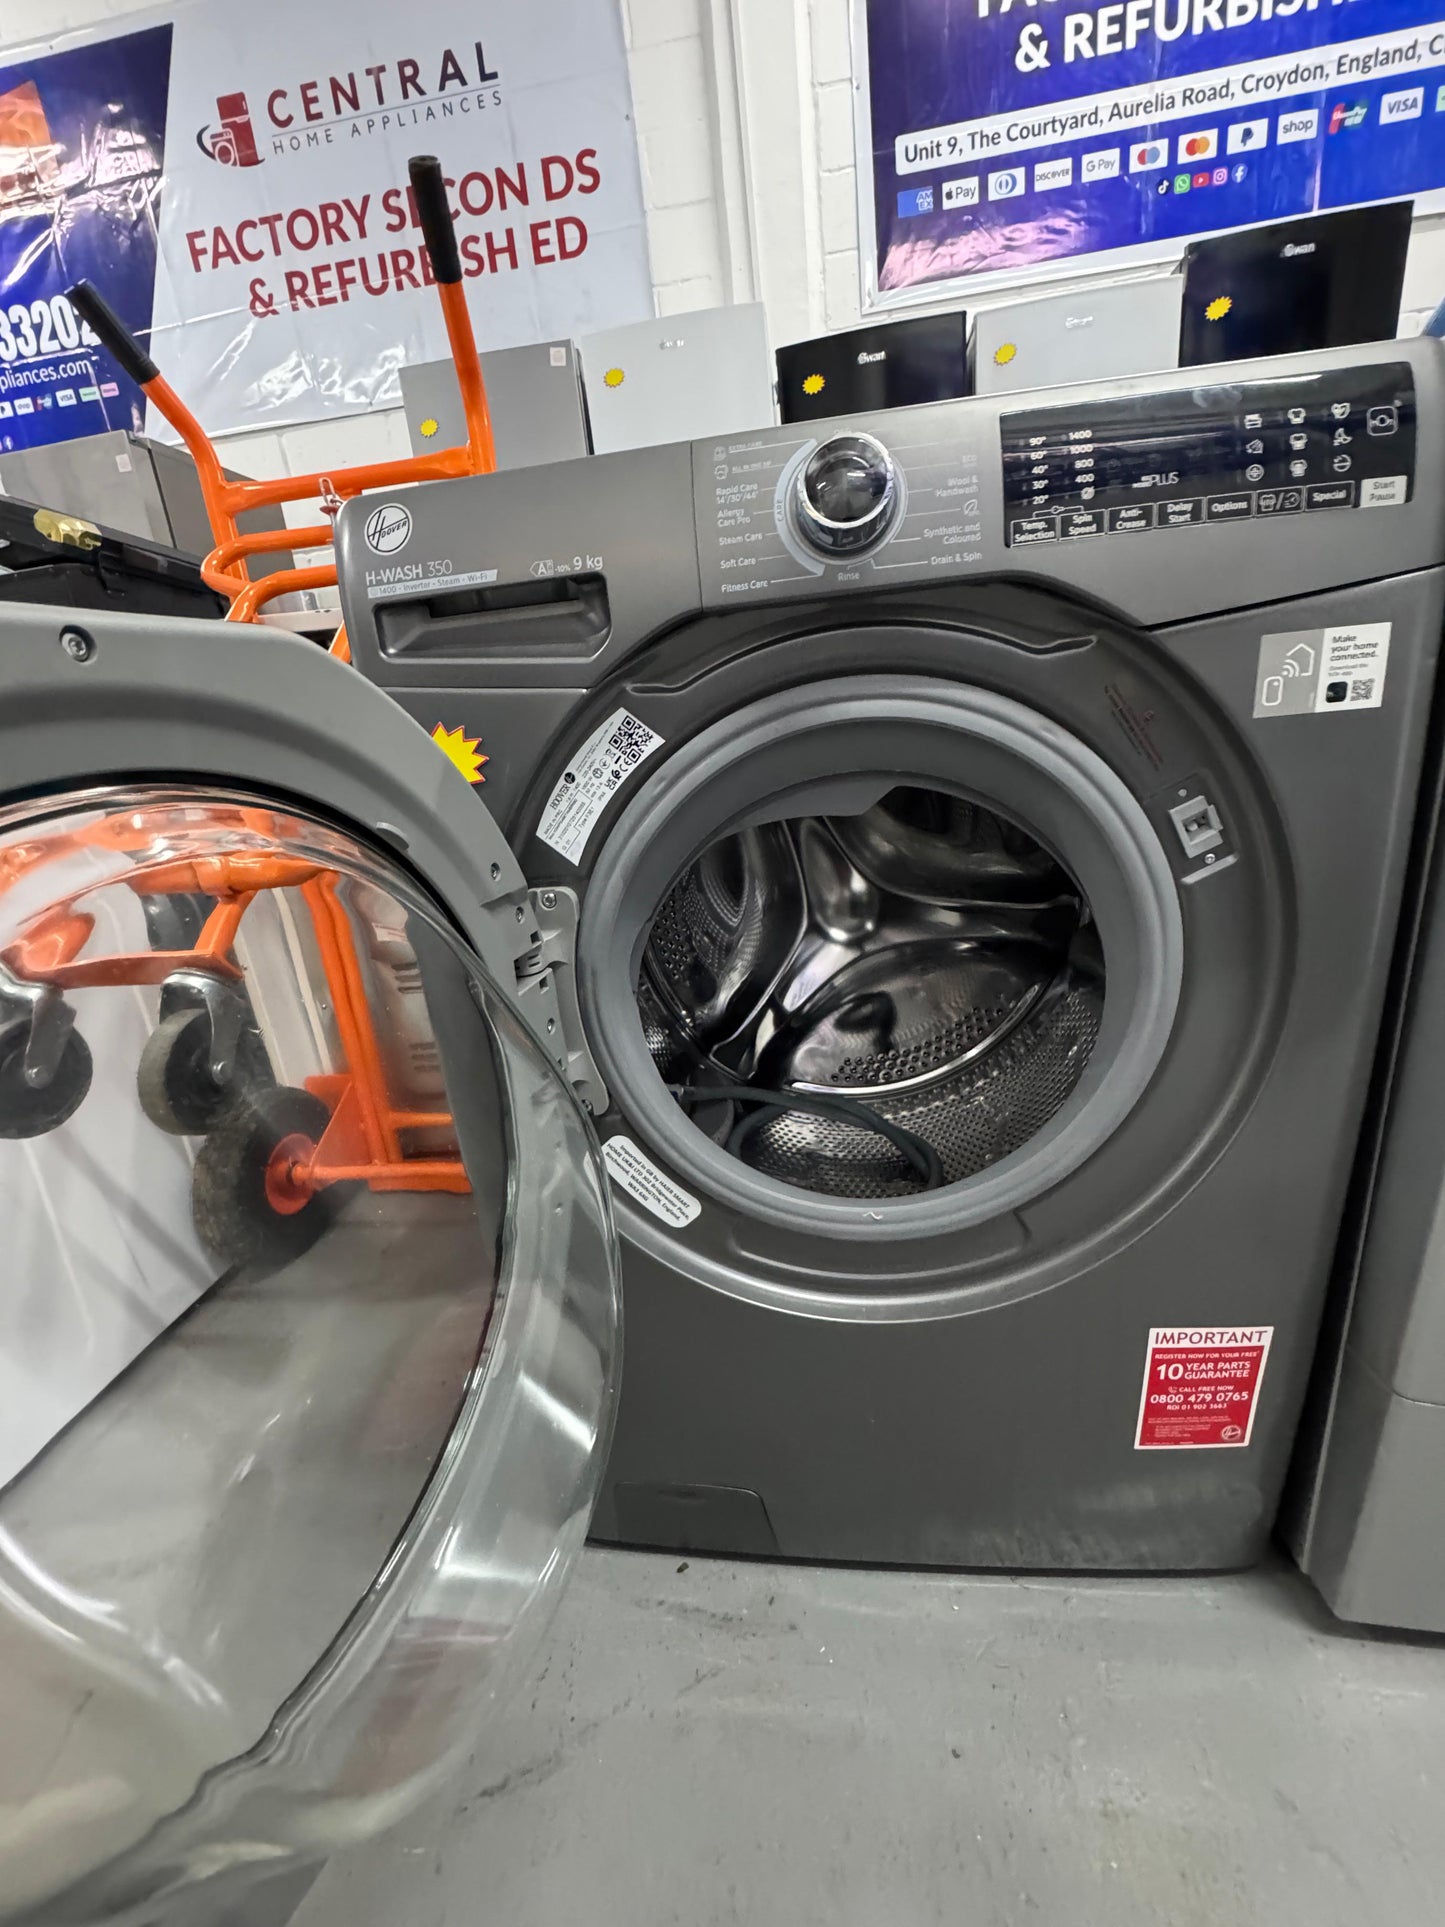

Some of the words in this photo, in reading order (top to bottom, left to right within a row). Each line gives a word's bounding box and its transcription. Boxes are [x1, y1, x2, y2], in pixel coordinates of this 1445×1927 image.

[1014, 24, 1050, 73] &
[1064, 0, 1349, 63] REFURB
[267, 41, 499, 129] CENTRAL
[904, 141, 942, 163] Unit
[947, 136, 963, 156] 9,
[967, 130, 1000, 150] The
[1006, 109, 1103, 142] Courtyard,
[1109, 92, 1175, 122] Aurelia
[1182, 78, 1235, 107] Road,
[1241, 63, 1329, 94] Croydon,
[1336, 39, 1422, 75] England,
[1429, 34, 1445, 56] C
[1388, 97, 1418, 115] VISA
[273, 128, 334, 155] HOME
[351, 90, 502, 138] APPLIANCES
[1282, 119, 1313, 135] shop
[1098, 158, 1115, 173] Pay
[955, 184, 976, 200] Pay
[186, 194, 371, 272] FACTORY
[383, 162, 529, 232] SON
[541, 147, 600, 203] DS
[249, 277, 280, 319] &
[284, 227, 519, 311] REFURSH
[530, 215, 588, 266] ED
[0, 360, 91, 394] pliances.com
[1069, 430, 1092, 440] 1400
[1070, 444, 1093, 455] 1000
[1074, 459, 1094, 469] 800
[1075, 473, 1095, 484] 400
[715, 485, 738, 496] Rapid
[740, 483, 758, 492] Care
[1312, 490, 1347, 503] Special
[717, 508, 744, 518] Allergy
[1167, 502, 1193, 514] Delay
[1211, 501, 1248, 513] Options
[717, 518, 735, 527] Care
[737, 516, 751, 524] Pro
[1072, 514, 1093, 525] Spin
[1116, 518, 1147, 530] Crease
[1168, 513, 1191, 523] Start
[923, 524, 963, 538] Synthetic
[964, 521, 980, 532] and
[1021, 520, 1048, 530] Temp.
[1069, 524, 1097, 535] Speed
[719, 535, 744, 546] Steam
[745, 533, 763, 543] Care
[943, 531, 982, 545] Coloured
[1014, 530, 1055, 542] Selection
[573, 556, 582, 571] 9
[586, 555, 603, 570] kg
[720, 559, 737, 569] Soft
[738, 557, 757, 567] Care
[931, 553, 954, 565] Drain
[955, 553, 961, 562] &
[963, 551, 982, 563] Spin
[365, 563, 423, 586] H-WASH
[427, 559, 453, 577] 350
[838, 571, 861, 582] Rinse
[379, 586, 396, 594] 1400
[404, 580, 430, 591] Inverter
[439, 577, 461, 587] Steam
[467, 573, 488, 583] Wi-Fi
[721, 581, 749, 593] Fitness
[750, 579, 768, 590] Care
[1353, 642, 1379, 650] home
[1330, 650, 1379, 661] connected.
[549, 784, 571, 810] HOOVER
[607, 1143, 622, 1157] HOME
[634, 1168, 643, 1176] LTD
[642, 1176, 652, 1184] 302
[651, 1183, 677, 1207] Bridgewater
[620, 1145, 642, 1165] Imported
[659, 1181, 673, 1194] HAIER
[673, 1193, 690, 1208] SMART
[1155, 1330, 1267, 1345] IMPORTANT
[1157, 1363, 1184, 1380] 10
[1186, 1362, 1214, 1371] YEAR
[1217, 1361, 1250, 1370] PARTS
[1184, 1369, 1249, 1379] GUARANTEE
[1150, 1394, 1184, 1404] 0800
[1187, 1393, 1212, 1403] 479
[1216, 1391, 1249, 1401] 0765
